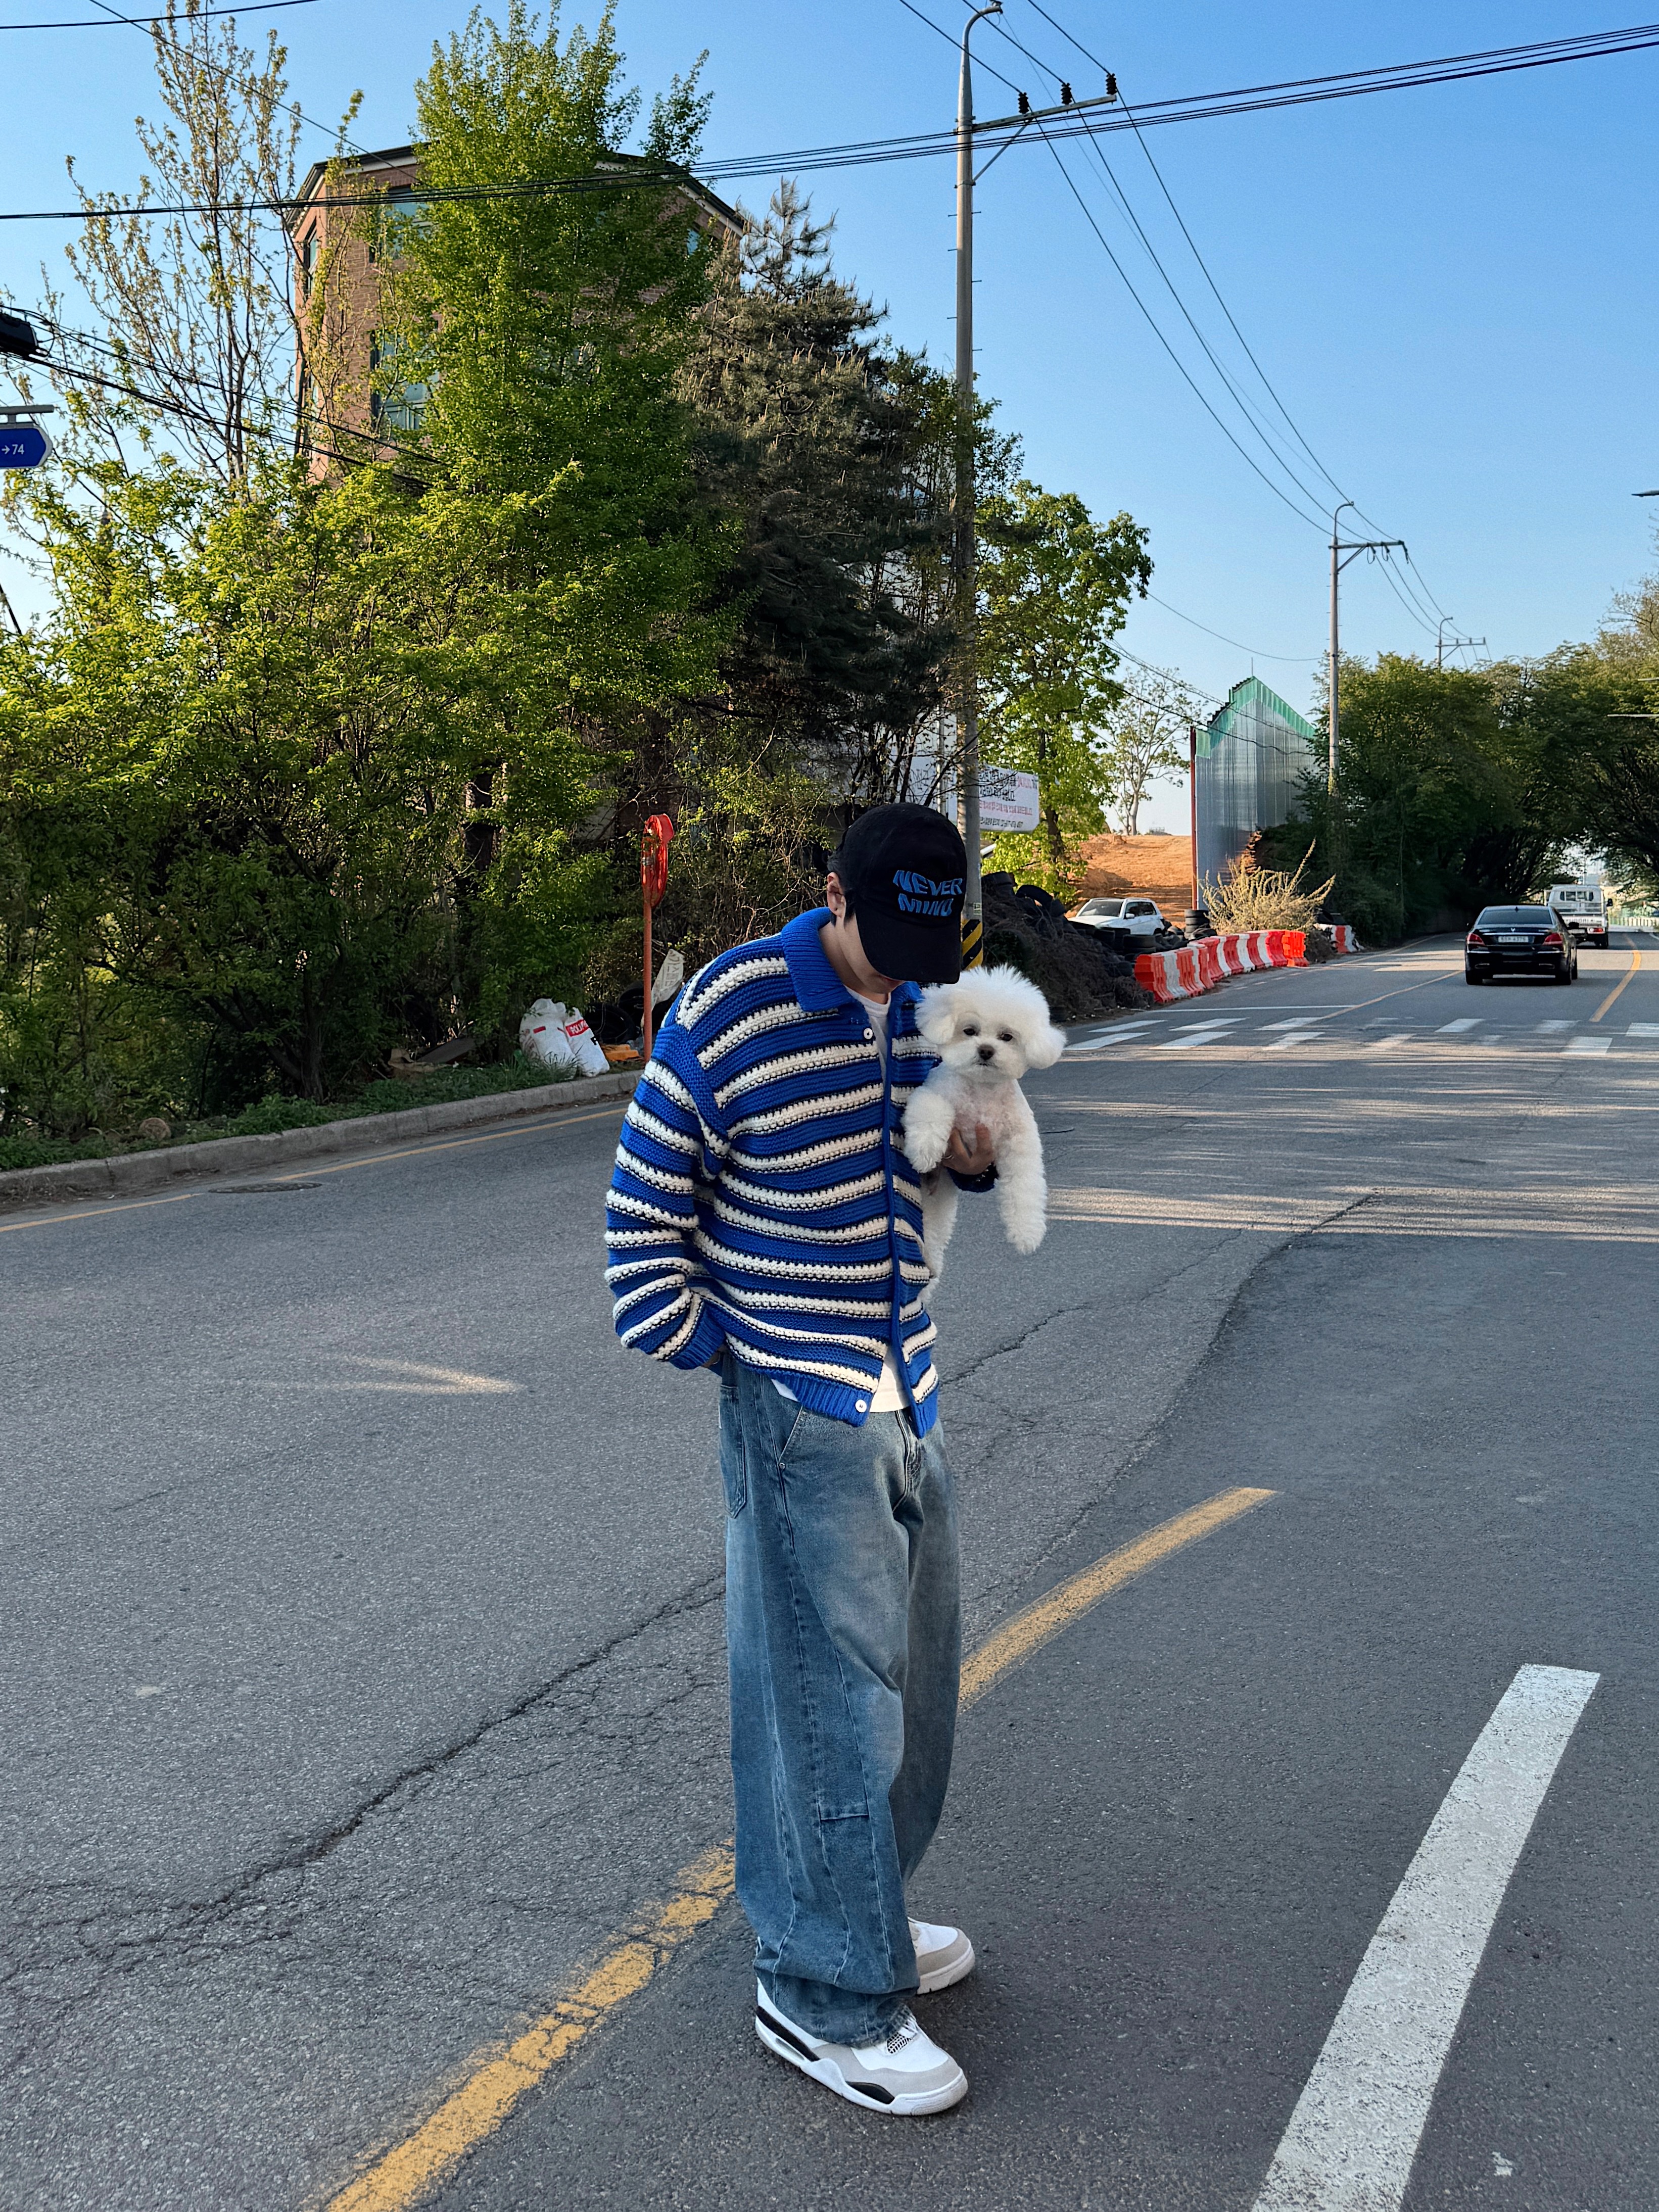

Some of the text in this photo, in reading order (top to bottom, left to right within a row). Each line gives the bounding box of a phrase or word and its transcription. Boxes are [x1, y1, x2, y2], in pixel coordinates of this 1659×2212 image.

[12, 444, 25, 455] 74
[892, 870, 963, 896] NEVER
[897, 893, 954, 917] MIND
